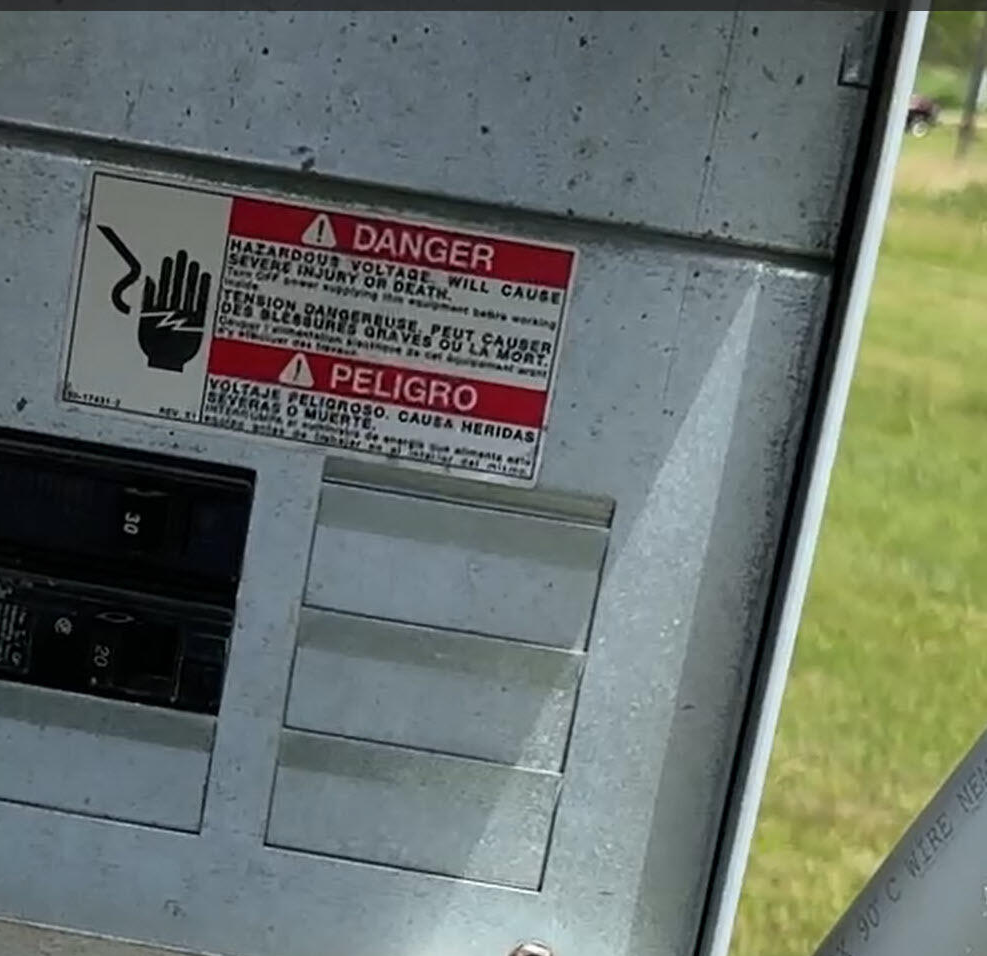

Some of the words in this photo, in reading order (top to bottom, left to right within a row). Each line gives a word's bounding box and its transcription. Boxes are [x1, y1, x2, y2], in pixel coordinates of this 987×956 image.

[230, 238, 339, 268] HAZARDOUS
[447, 273, 490, 293] WILL
[500, 282, 561, 304] CAUSE
[352, 223, 495, 271] DANGER
[228, 252, 291, 275] SEVERE
[296, 263, 357, 285] INJURY
[363, 274, 387, 290] OR
[392, 279, 453, 301] DEATH.
[221, 301, 253, 318] DES
[260, 307, 357, 335] BLESSURES
[364, 324, 433, 348] GRAVES
[438, 337, 462, 353] OU
[468, 342, 489, 357] LA
[495, 346, 549, 368] MORT.
[223, 289, 296, 312] TENSION
[430, 323, 474, 342] PEUT
[481, 331, 552, 355] CAUSER
[206, 390, 281, 414] SEVERAS
[286, 404, 298, 417] O
[303, 407, 377, 431] MUERTE.
[208, 376, 281, 400] VOLTAJE
[288, 390, 390, 420] PELIGROSO.
[397, 409, 453, 431] CAUSA
[460, 420, 535, 445] HERIDAS
[329, 361, 479, 413] PELIGRO
[122, 510, 142, 535] 30
[92, 644, 111, 668] 20
[885, 877, 902, 903] C
[904, 812, 954, 878] WIRE
